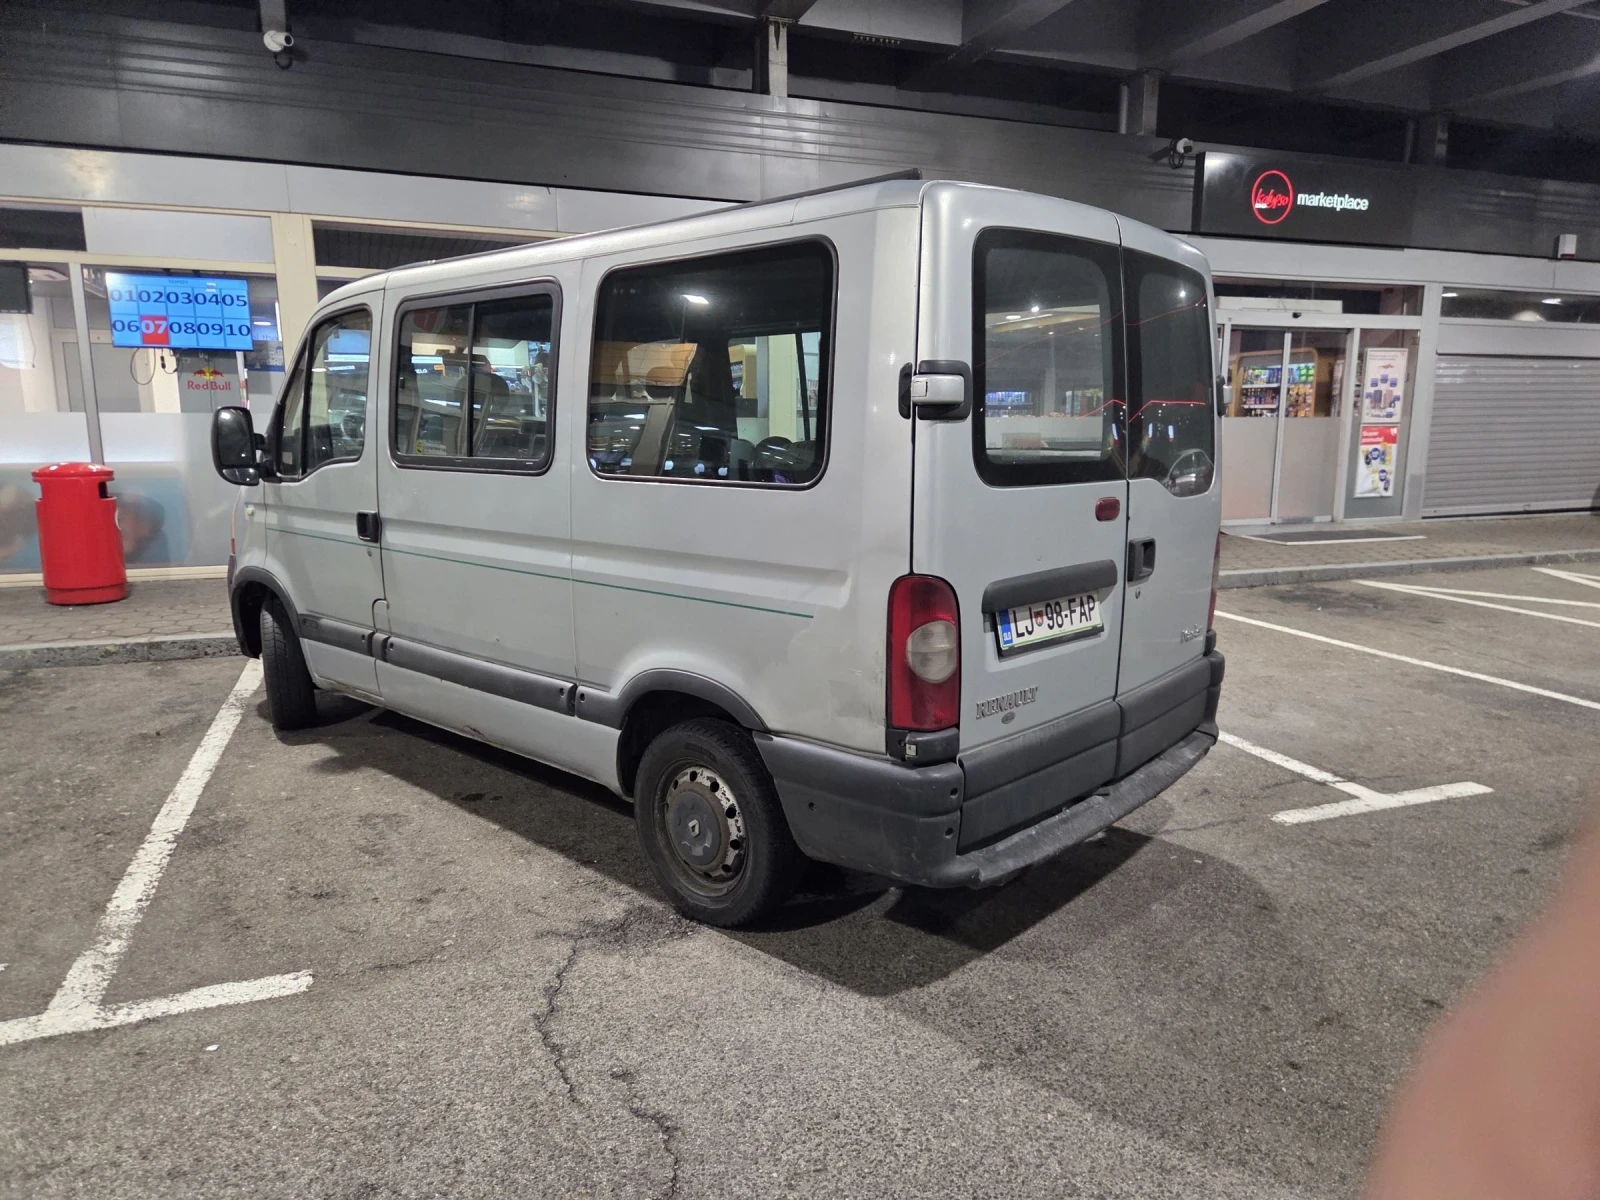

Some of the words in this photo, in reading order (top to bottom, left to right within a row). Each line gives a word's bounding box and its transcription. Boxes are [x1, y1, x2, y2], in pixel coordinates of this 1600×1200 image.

[1297, 192, 1369, 211] marketplace
[110, 289, 136, 302] 01
[138, 290, 166, 303] 02
[167, 292, 193, 304] 03
[194, 293, 221, 306] 04
[222, 294, 248, 307] 05
[113, 320, 139, 333] 06
[142, 320, 167, 335] 07
[169, 322, 196, 335] 08
[197, 323, 223, 336] 09
[225, 324, 251, 337] 10
[187, 381, 209, 391] Red
[210, 381, 231, 391] Bull
[1013, 606, 1035, 638] LJ
[1045, 594, 1096, 631] 98-FAP
[976, 685, 1039, 720] RENAULT
